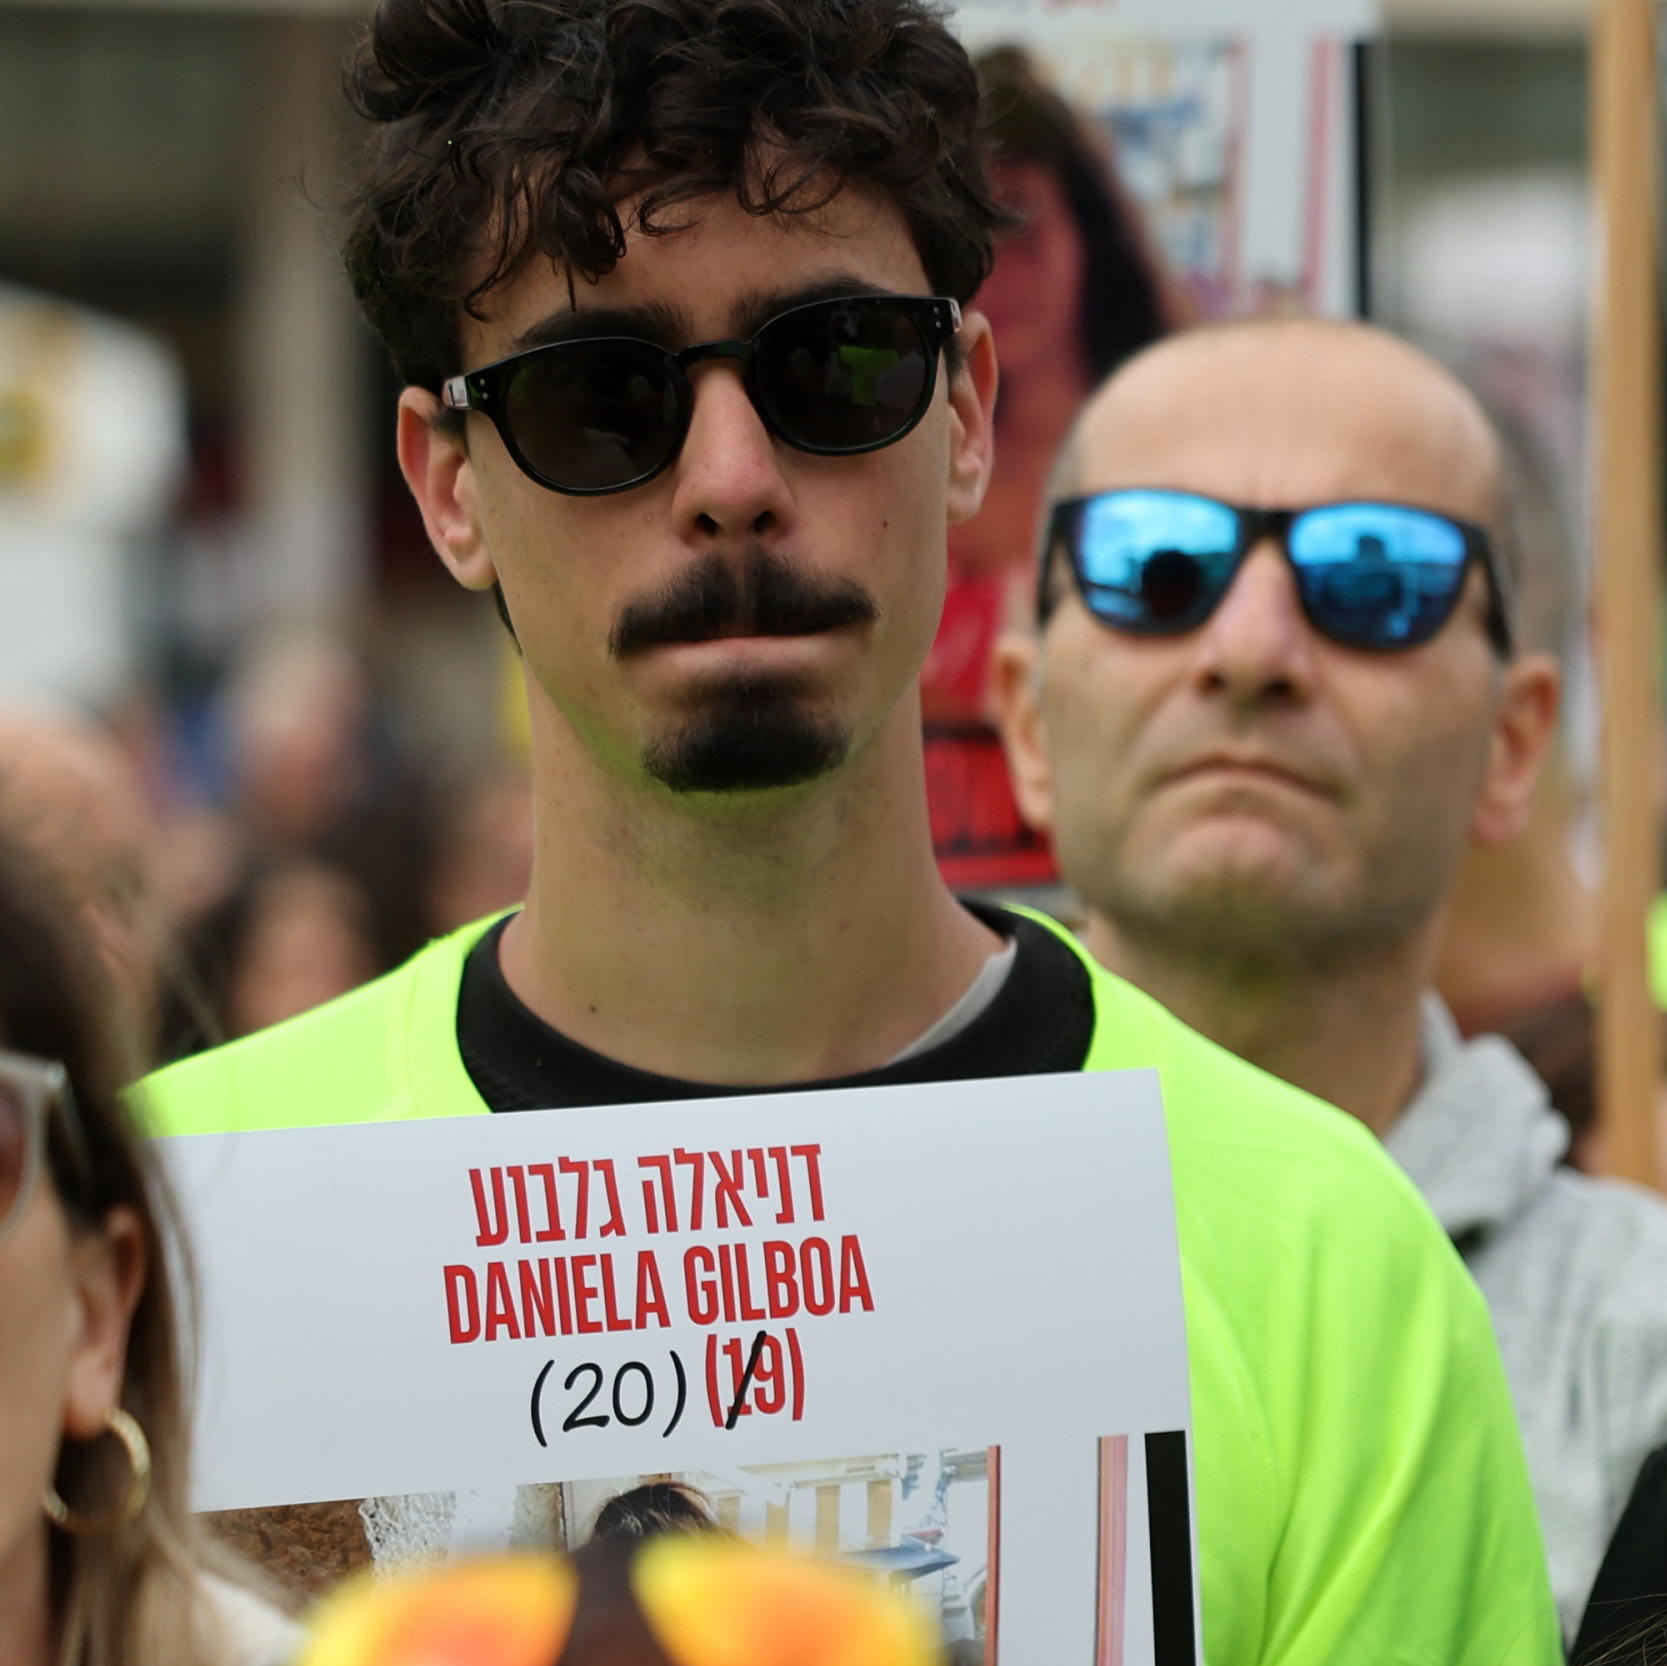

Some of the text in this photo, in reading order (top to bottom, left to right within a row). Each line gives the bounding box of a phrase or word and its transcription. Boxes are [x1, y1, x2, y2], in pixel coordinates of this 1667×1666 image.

[468, 1143, 826, 1248] דניאלה גלבוע
[442, 1234, 875, 1345] DANIELA GILBOA
[530, 1350, 688, 1448] (20)
[705, 1327, 805, 1431] (19)
